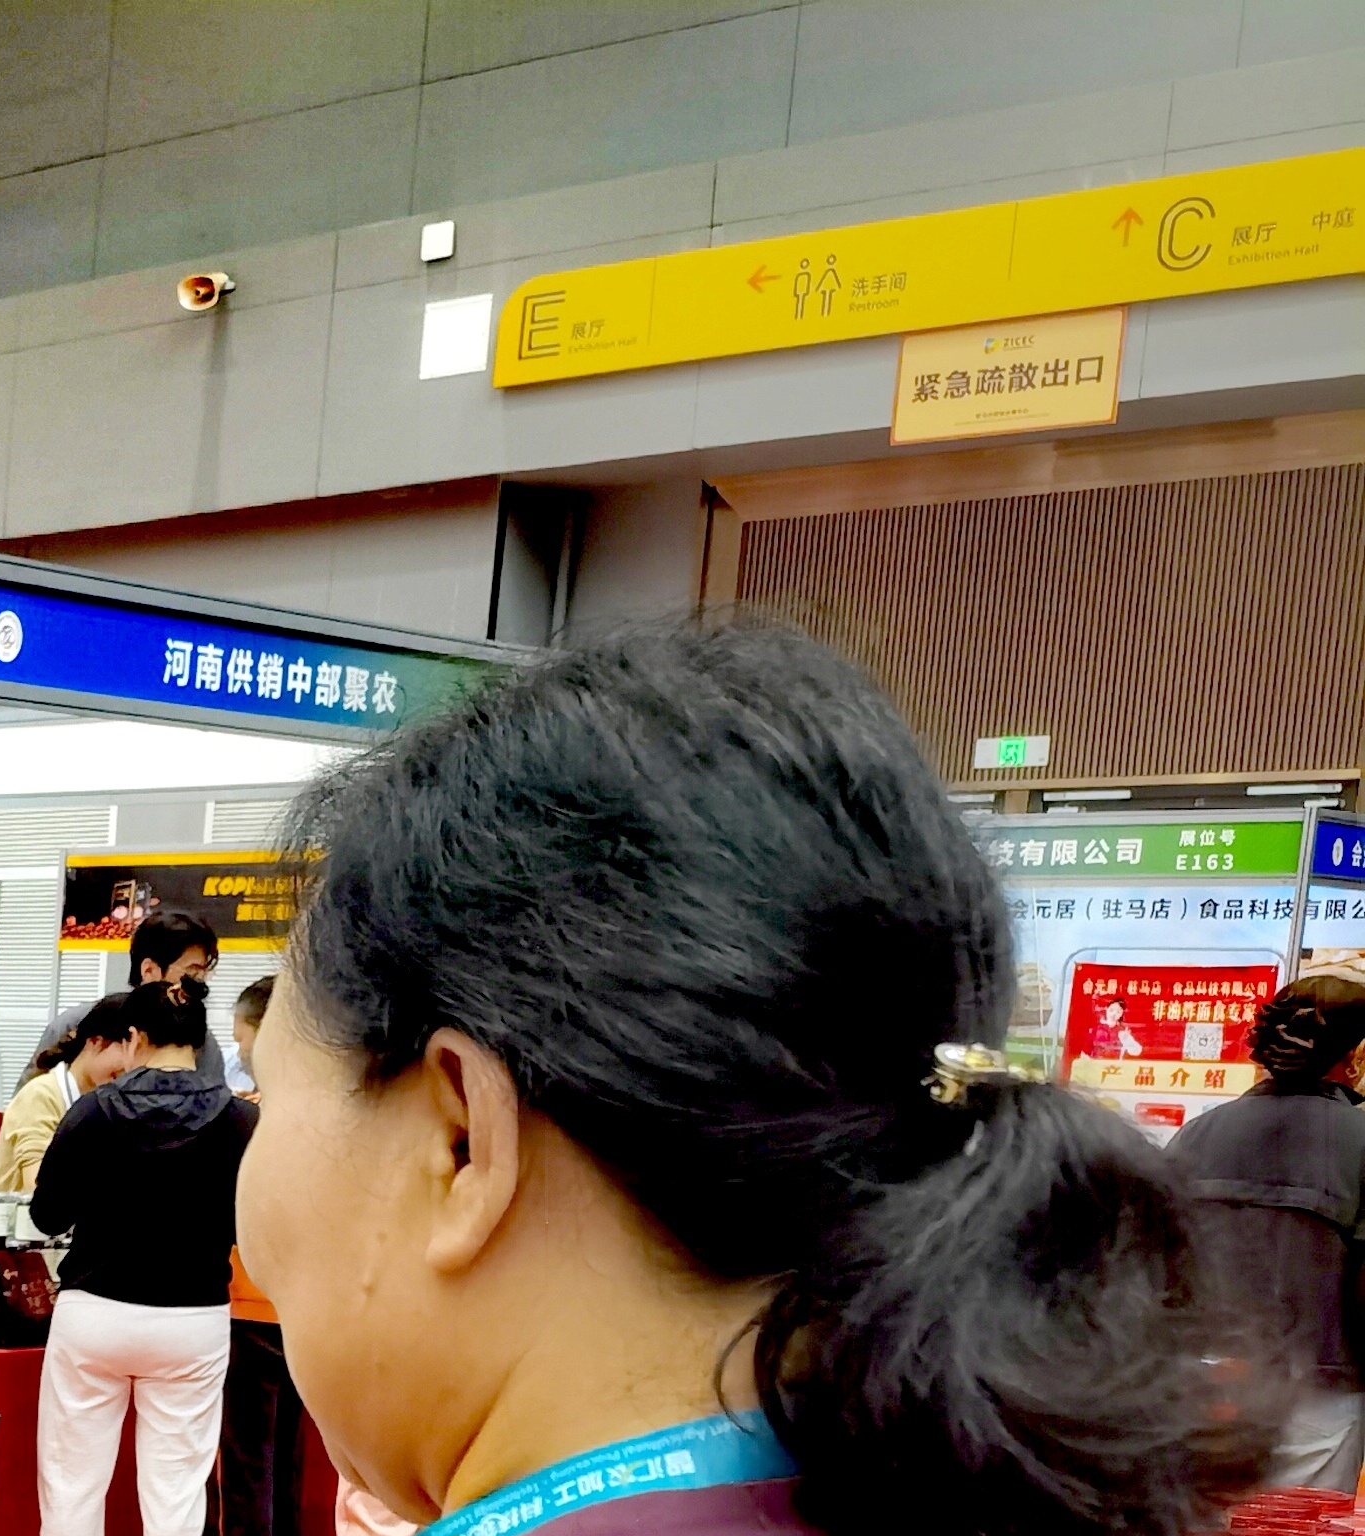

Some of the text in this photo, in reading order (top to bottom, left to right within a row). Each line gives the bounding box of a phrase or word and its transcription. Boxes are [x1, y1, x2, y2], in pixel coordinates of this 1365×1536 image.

[1156, 196, 1216, 271] C
[1231, 222, 1277, 247] 展厅
[851, 271, 907, 298] 洗手间
[517, 290, 566, 361] E
[911, 355, 1104, 404] 紧急疏散出口
[162, 638, 398, 714] 河南供销中部聚农
[1179, 829, 1235, 847] 展位号
[972, 838, 1143, 867] 技有限公司
[1176, 852, 1234, 870] E163
[1101, 1065, 1226, 1088] 产品介绍
